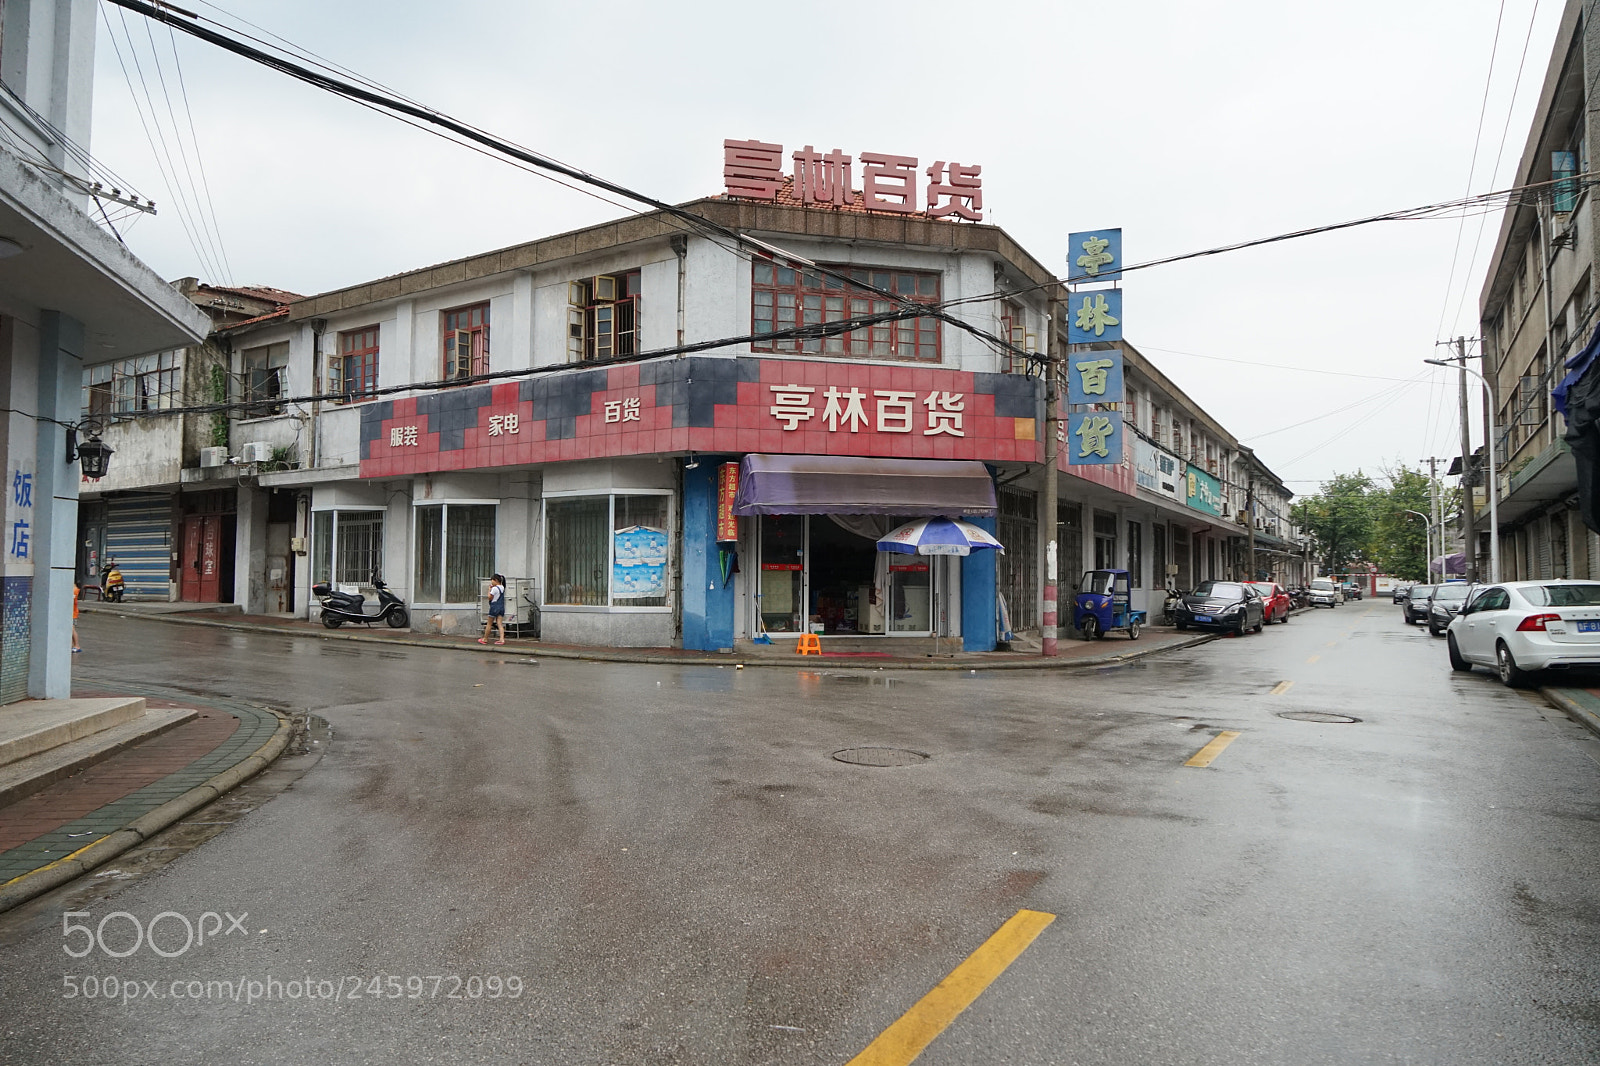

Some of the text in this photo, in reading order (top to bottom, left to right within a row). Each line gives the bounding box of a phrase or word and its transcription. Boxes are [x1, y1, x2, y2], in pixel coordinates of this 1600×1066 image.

[724, 139, 983, 221] 亭林百货
[1076, 236, 1120, 458] 亭林百貨
[390, 425, 418, 447] 服装
[488, 412, 520, 437] 家电
[604, 397, 641, 424] 百货
[769, 383, 965, 437] 亭林百货
[11, 469, 32, 558] 饭店
